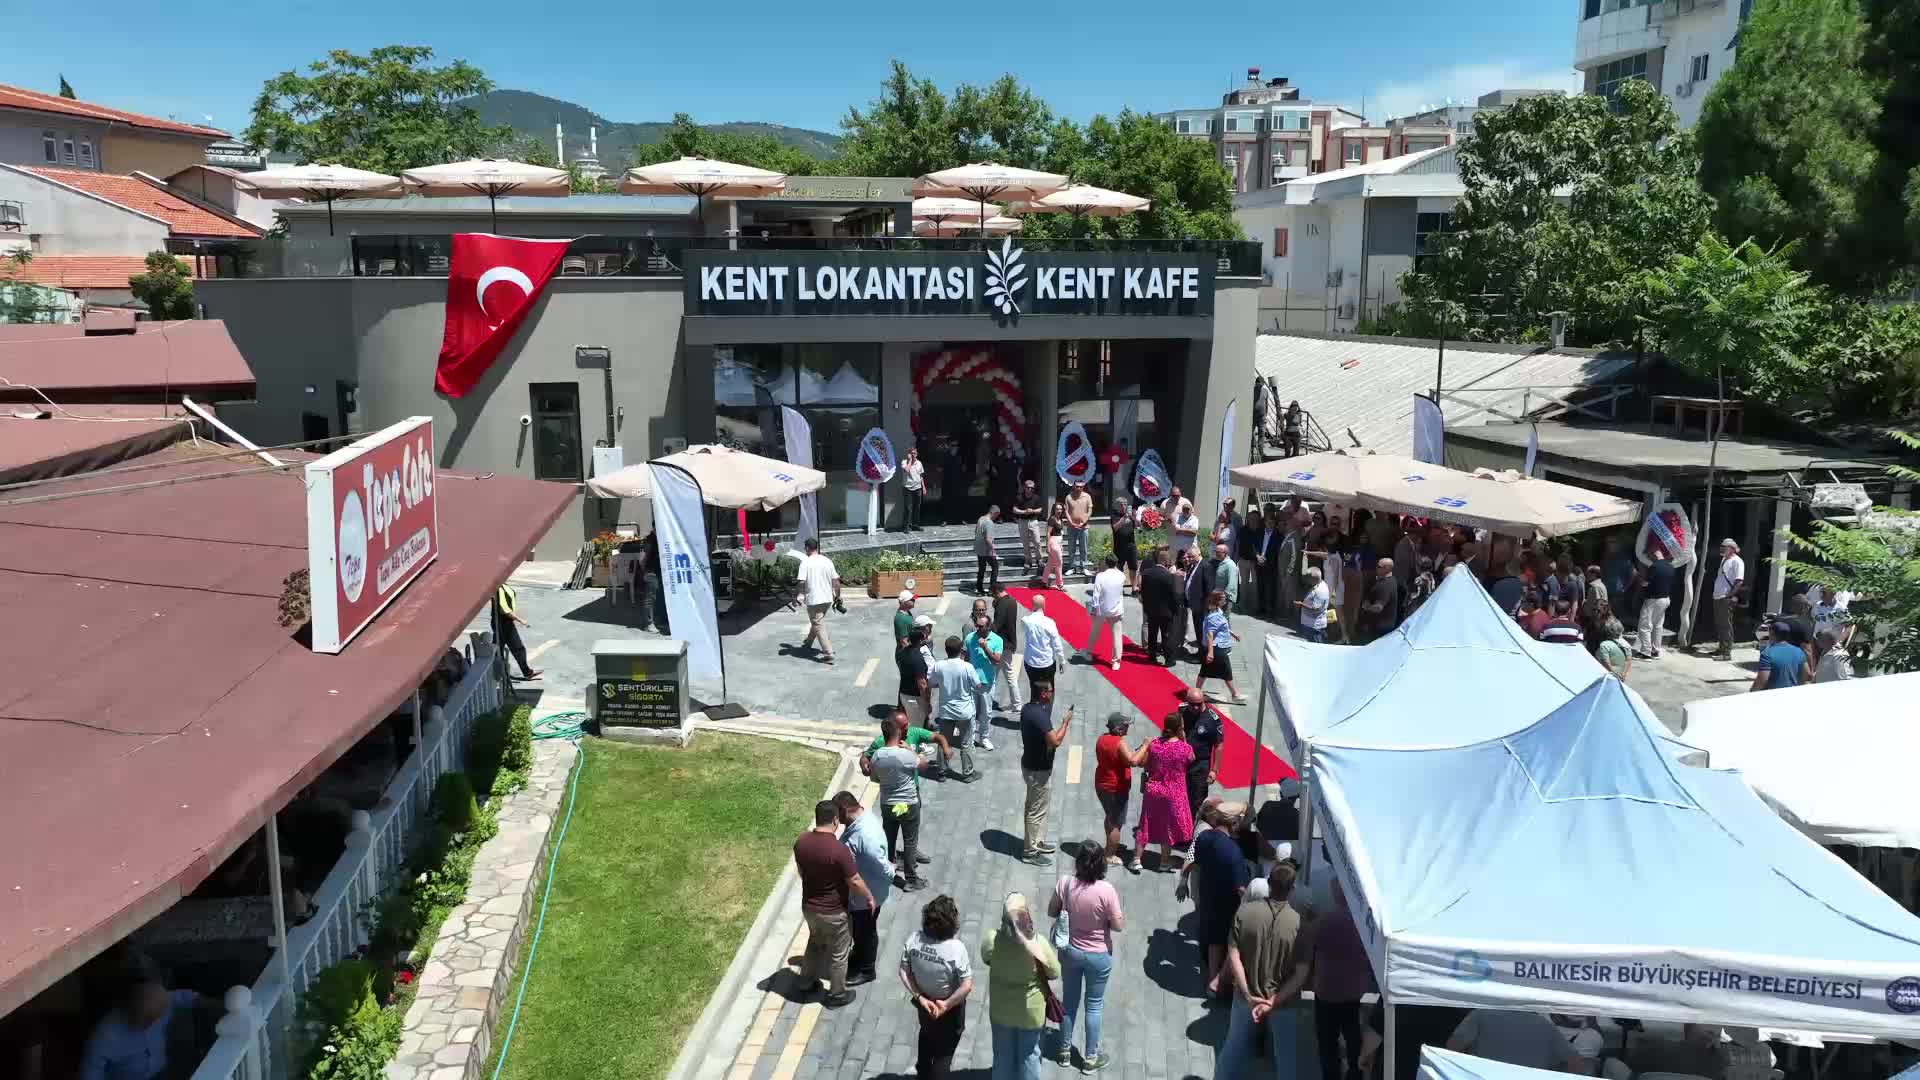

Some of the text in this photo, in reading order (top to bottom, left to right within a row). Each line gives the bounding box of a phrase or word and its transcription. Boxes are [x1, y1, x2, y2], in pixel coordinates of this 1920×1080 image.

[701, 265, 974, 301] KENT LOKANTASI
[1036, 267, 1199, 300] KENT KAFE
[363, 462, 401, 550] Tepe
[629, 692, 664, 701] SİGORTA
[1513, 961, 1864, 1000] BALIKESİR BÜYÜKŞEHİR BELEDİYESİ
